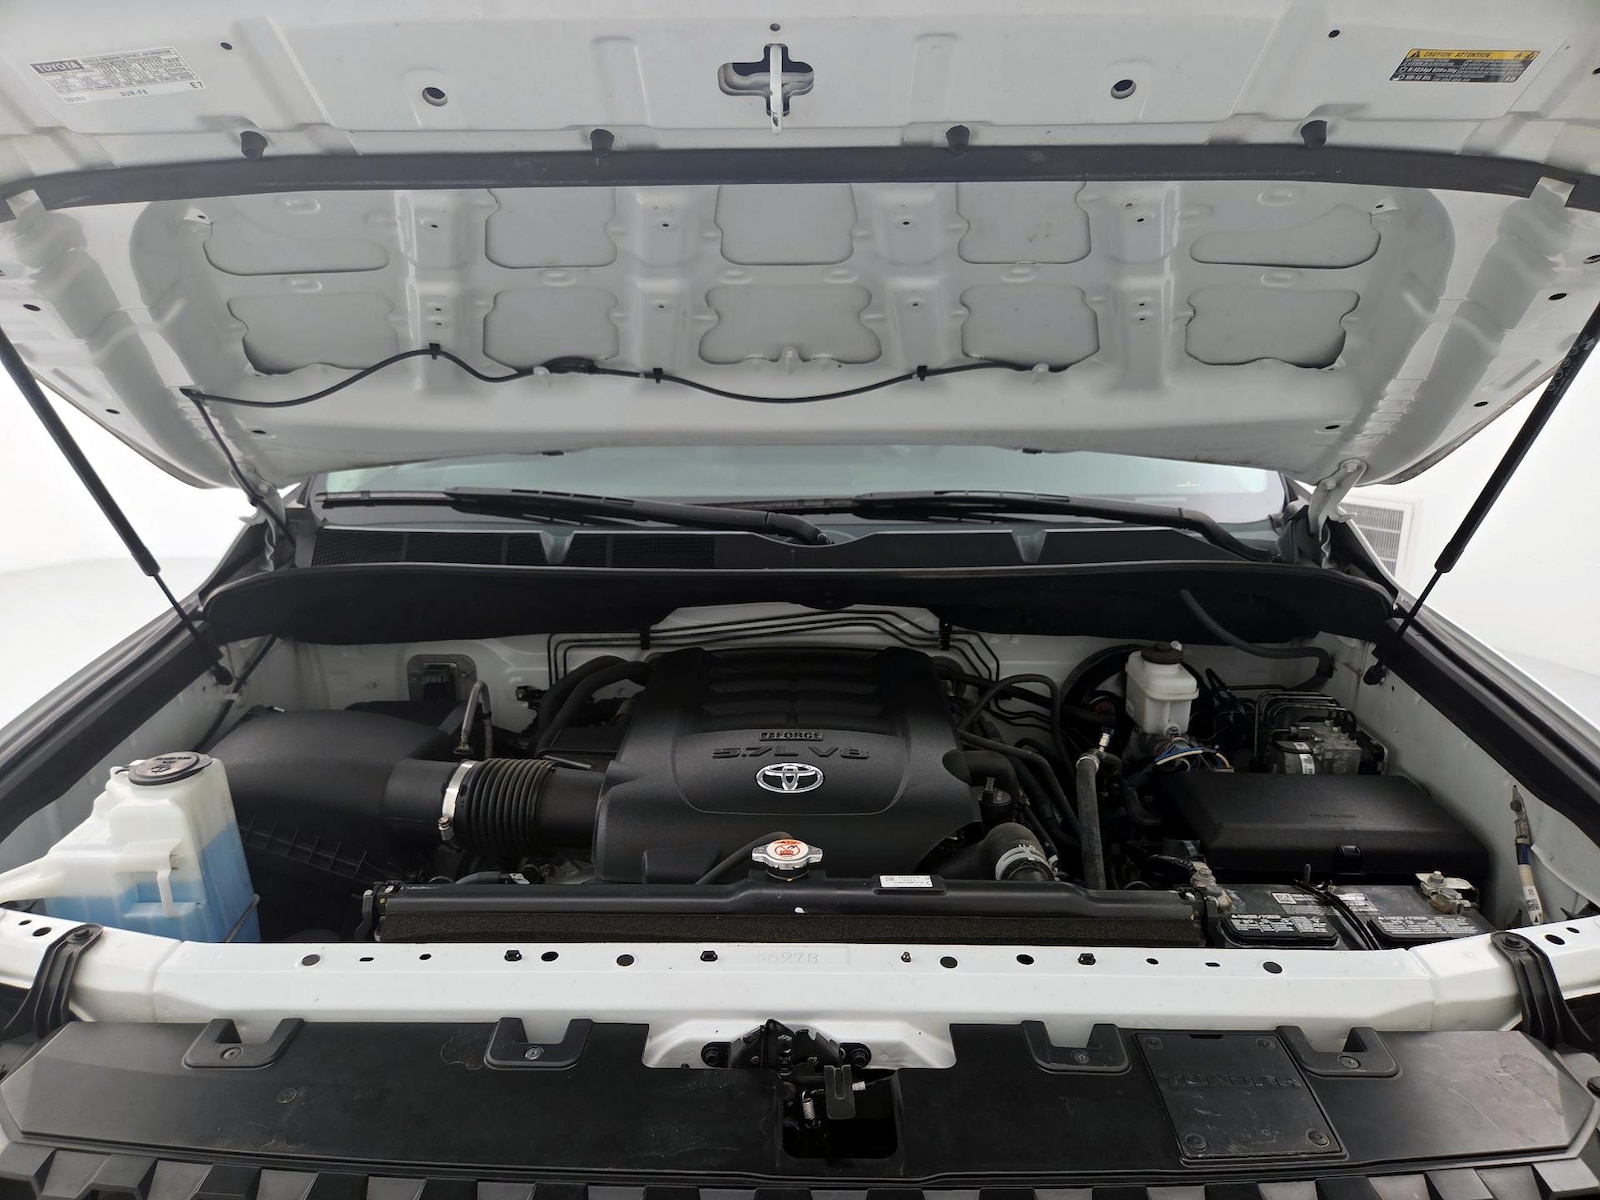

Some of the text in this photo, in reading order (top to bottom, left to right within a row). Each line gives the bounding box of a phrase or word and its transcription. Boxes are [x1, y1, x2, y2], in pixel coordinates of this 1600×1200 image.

[35, 61, 81, 73] TOYOTA
[190, 81, 204, 89] E7
[712, 746, 870, 760] 5.7L V8
